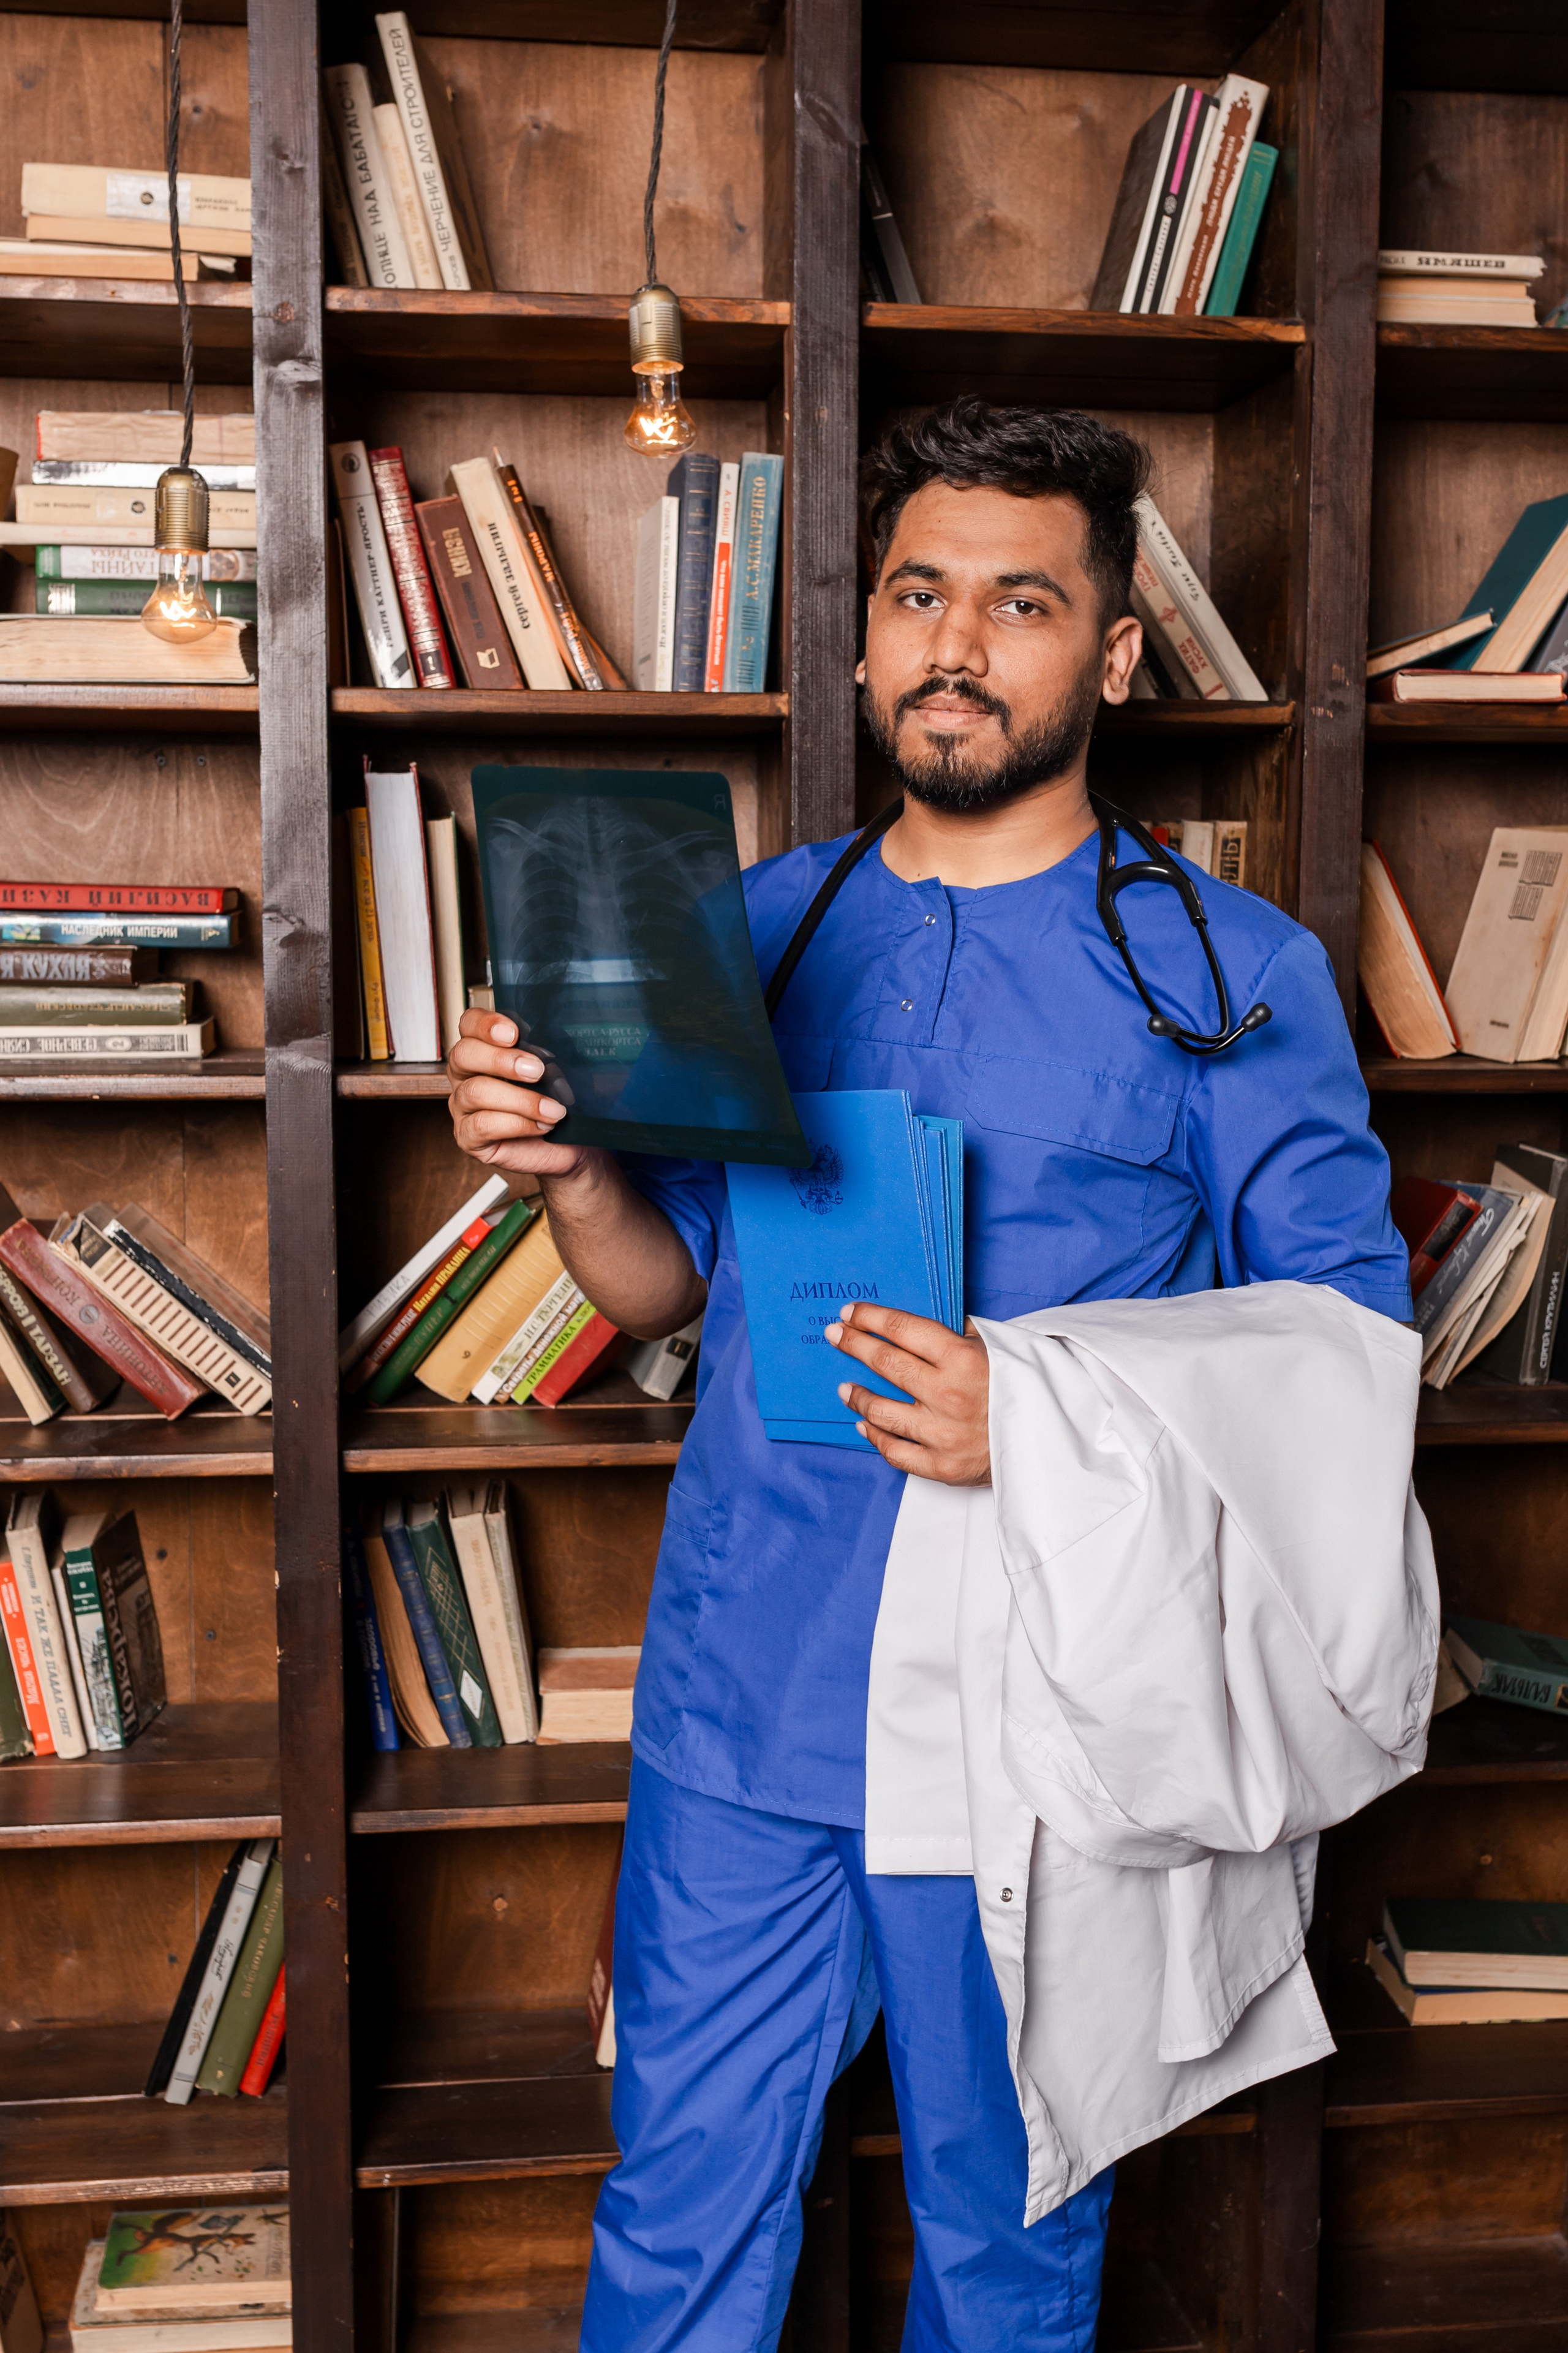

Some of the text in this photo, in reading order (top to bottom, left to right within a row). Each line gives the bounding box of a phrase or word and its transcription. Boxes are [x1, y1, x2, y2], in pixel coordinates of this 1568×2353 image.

[385, 26, 426, 129] СТРОИТЕЛЕЙ
[413, 132, 434, 166] ДЛЯ
[362, 188, 383, 225] НАД
[421, 168, 455, 252] ЧЕРЧЕНИЕ
[372, 231, 398, 290] ОЛНЦЕ
[721, 501, 731, 536] СВИЯШ
[742, 475, 769, 600] А.С.МАКАРЕНКО
[91, 559, 157, 578] ТАЙНЫ
[487, 521, 532, 630] сергей залыгин
[1177, 641, 1201, 674] ФАТИХ
[1183, 636, 1208, 670] ХУСНИ
[1221, 842, 1238, 885] ЛЬ
[1, 888, 208, 908] ВАСИЛИЙ КАЗИ
[61, 924, 178, 938] НАСЛЕДНИК ИМПЕРИИ
[0, 953, 90, 980] Я КУХНЯ
[0, 1037, 97, 1052] СЕВЕРНОЕ СИЯН
[521, 1277, 576, 1340] И.С.ТУРГЕН
[790, 1282, 880, 1302] ДИПЛОМ
[809, 1315, 842, 1326] О ВЫС
[1537, 1271, 1560, 1369] СЕРГЕЙ КРУТИЛИН
[27, 1323, 72, 1387] ТАРЗАН
[523, 1324, 579, 1385] ГРАММАТИКА
[801, 1334, 828, 1345] ОБРА
[98, 1324, 170, 1398] АНТОНИНА
[500, 1354, 538, 1394] Секреты
[31, 1593, 42, 1606] И
[33, 1607, 49, 1634] ТАК
[40, 1636, 53, 1657] ЖЕ
[43, 1660, 64, 1704] ПАДАЛ
[1492, 1674, 1551, 1703] БАЛЬЗАК
[56, 1706, 72, 1738] СНЕГ
[240, 1935, 266, 1999] ЧАКОВСКИЙ
